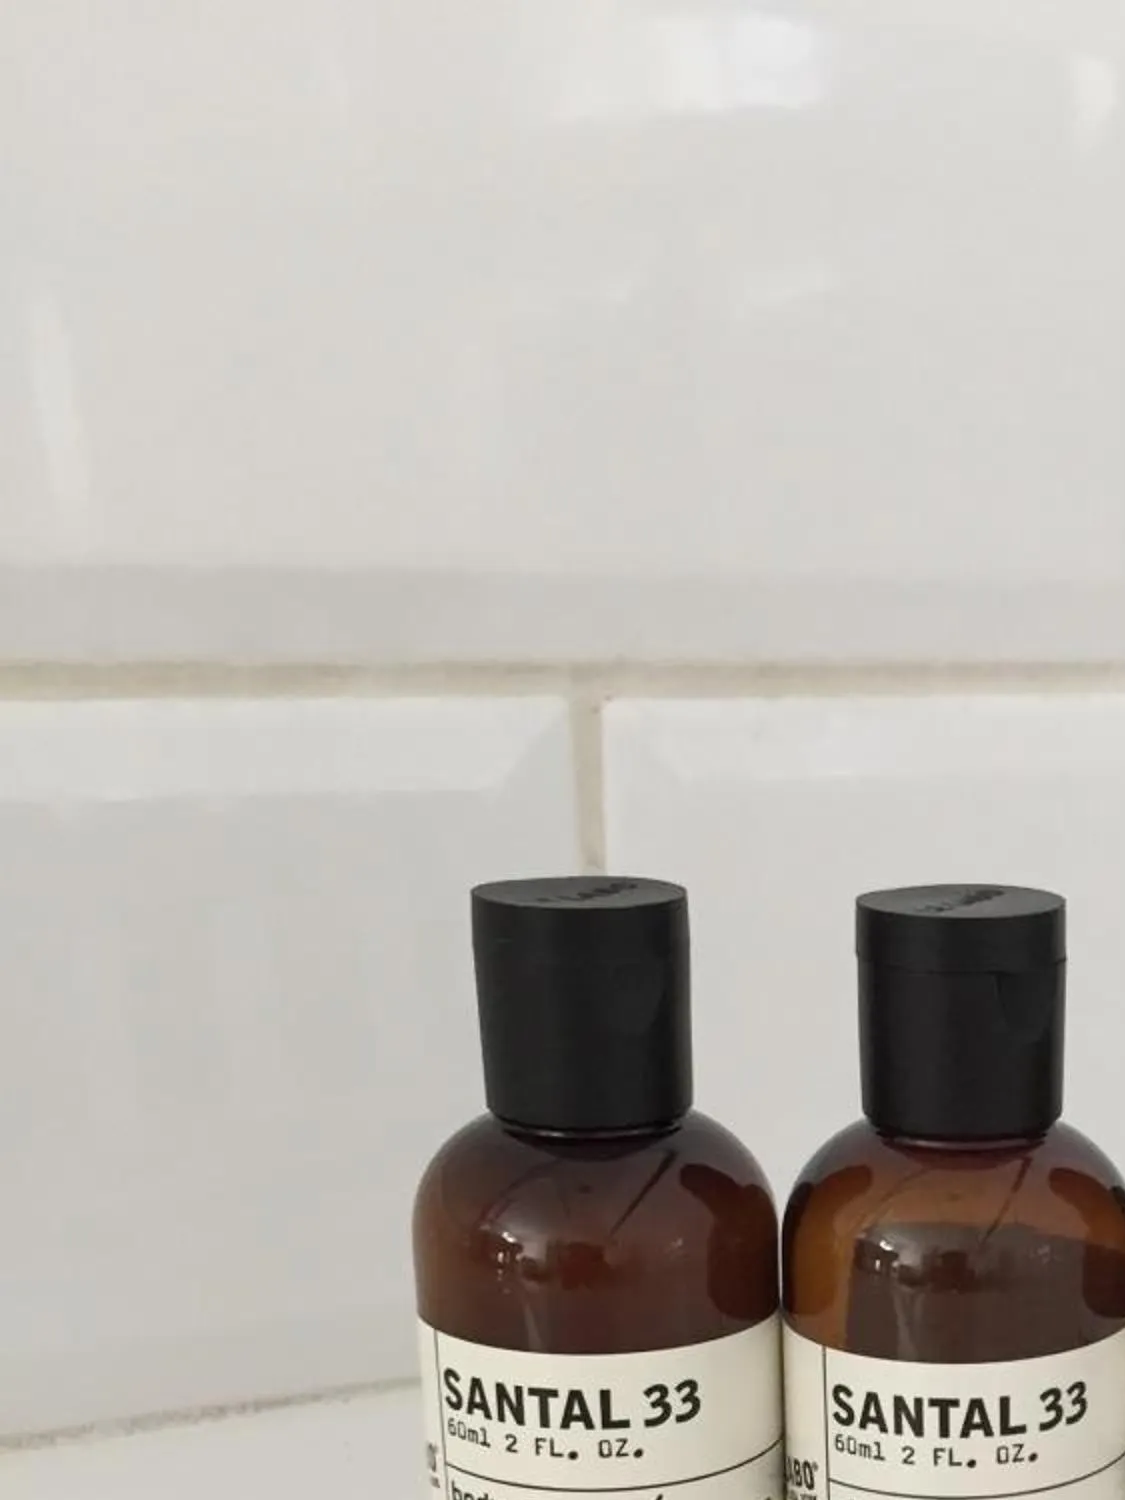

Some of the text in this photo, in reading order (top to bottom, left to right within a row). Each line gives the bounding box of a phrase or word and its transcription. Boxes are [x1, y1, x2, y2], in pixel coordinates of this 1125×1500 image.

[443, 1367, 702, 1431] SANTAL 33
[832, 1381, 1088, 1439] SANTAL 33
[447, 1418, 644, 1460] 60ml 2 FL. OZ.
[834, 1434, 1039, 1468] 60ml 2 FL. OZ.
